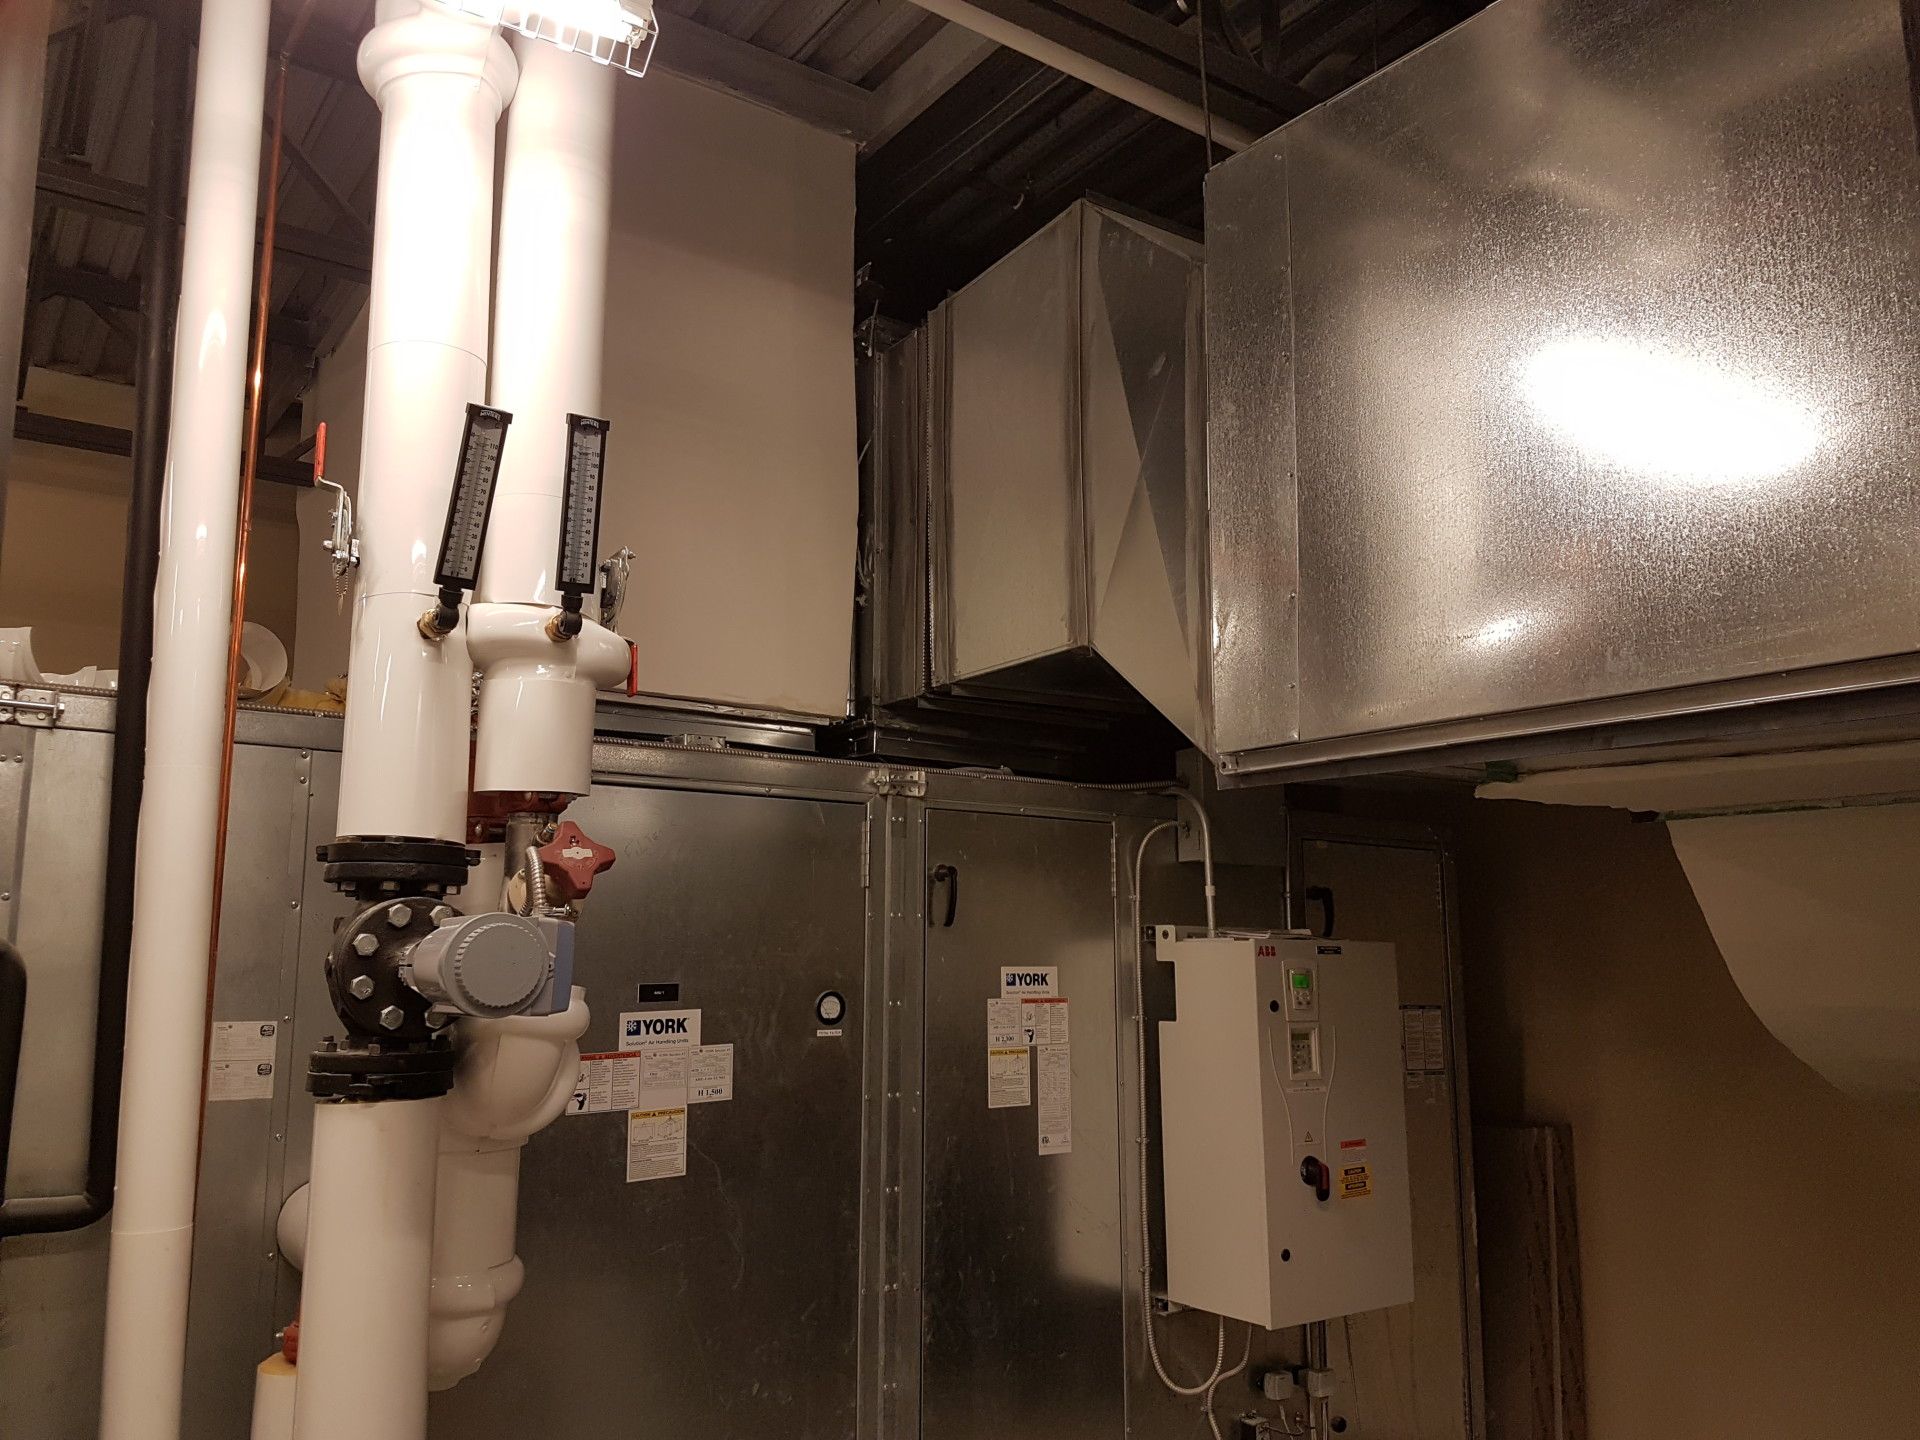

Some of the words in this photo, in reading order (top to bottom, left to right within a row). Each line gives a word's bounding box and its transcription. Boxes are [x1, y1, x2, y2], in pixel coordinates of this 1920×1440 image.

[1258, 945, 1276, 956] ABB
[1017, 973, 1048, 986] YORK
[642, 1017, 688, 1036] YORK
[706, 1088, 723, 1096] 1,500
